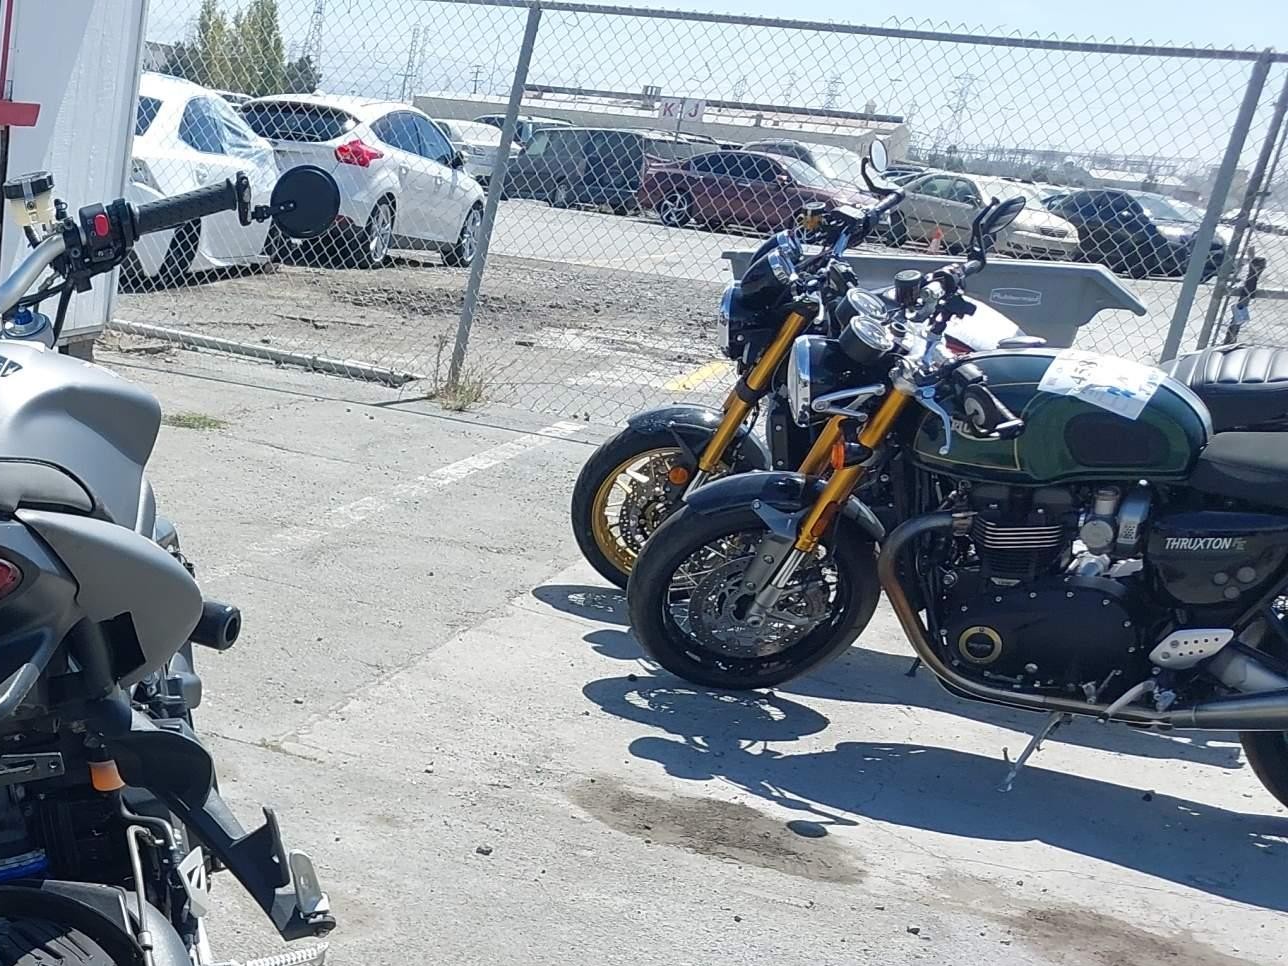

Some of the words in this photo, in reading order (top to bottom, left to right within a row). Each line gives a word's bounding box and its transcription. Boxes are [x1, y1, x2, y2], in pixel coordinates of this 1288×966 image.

[662, 102, 676, 117] K
[688, 103, 700, 118] J
[1165, 537, 1232, 551] THRUXTON
